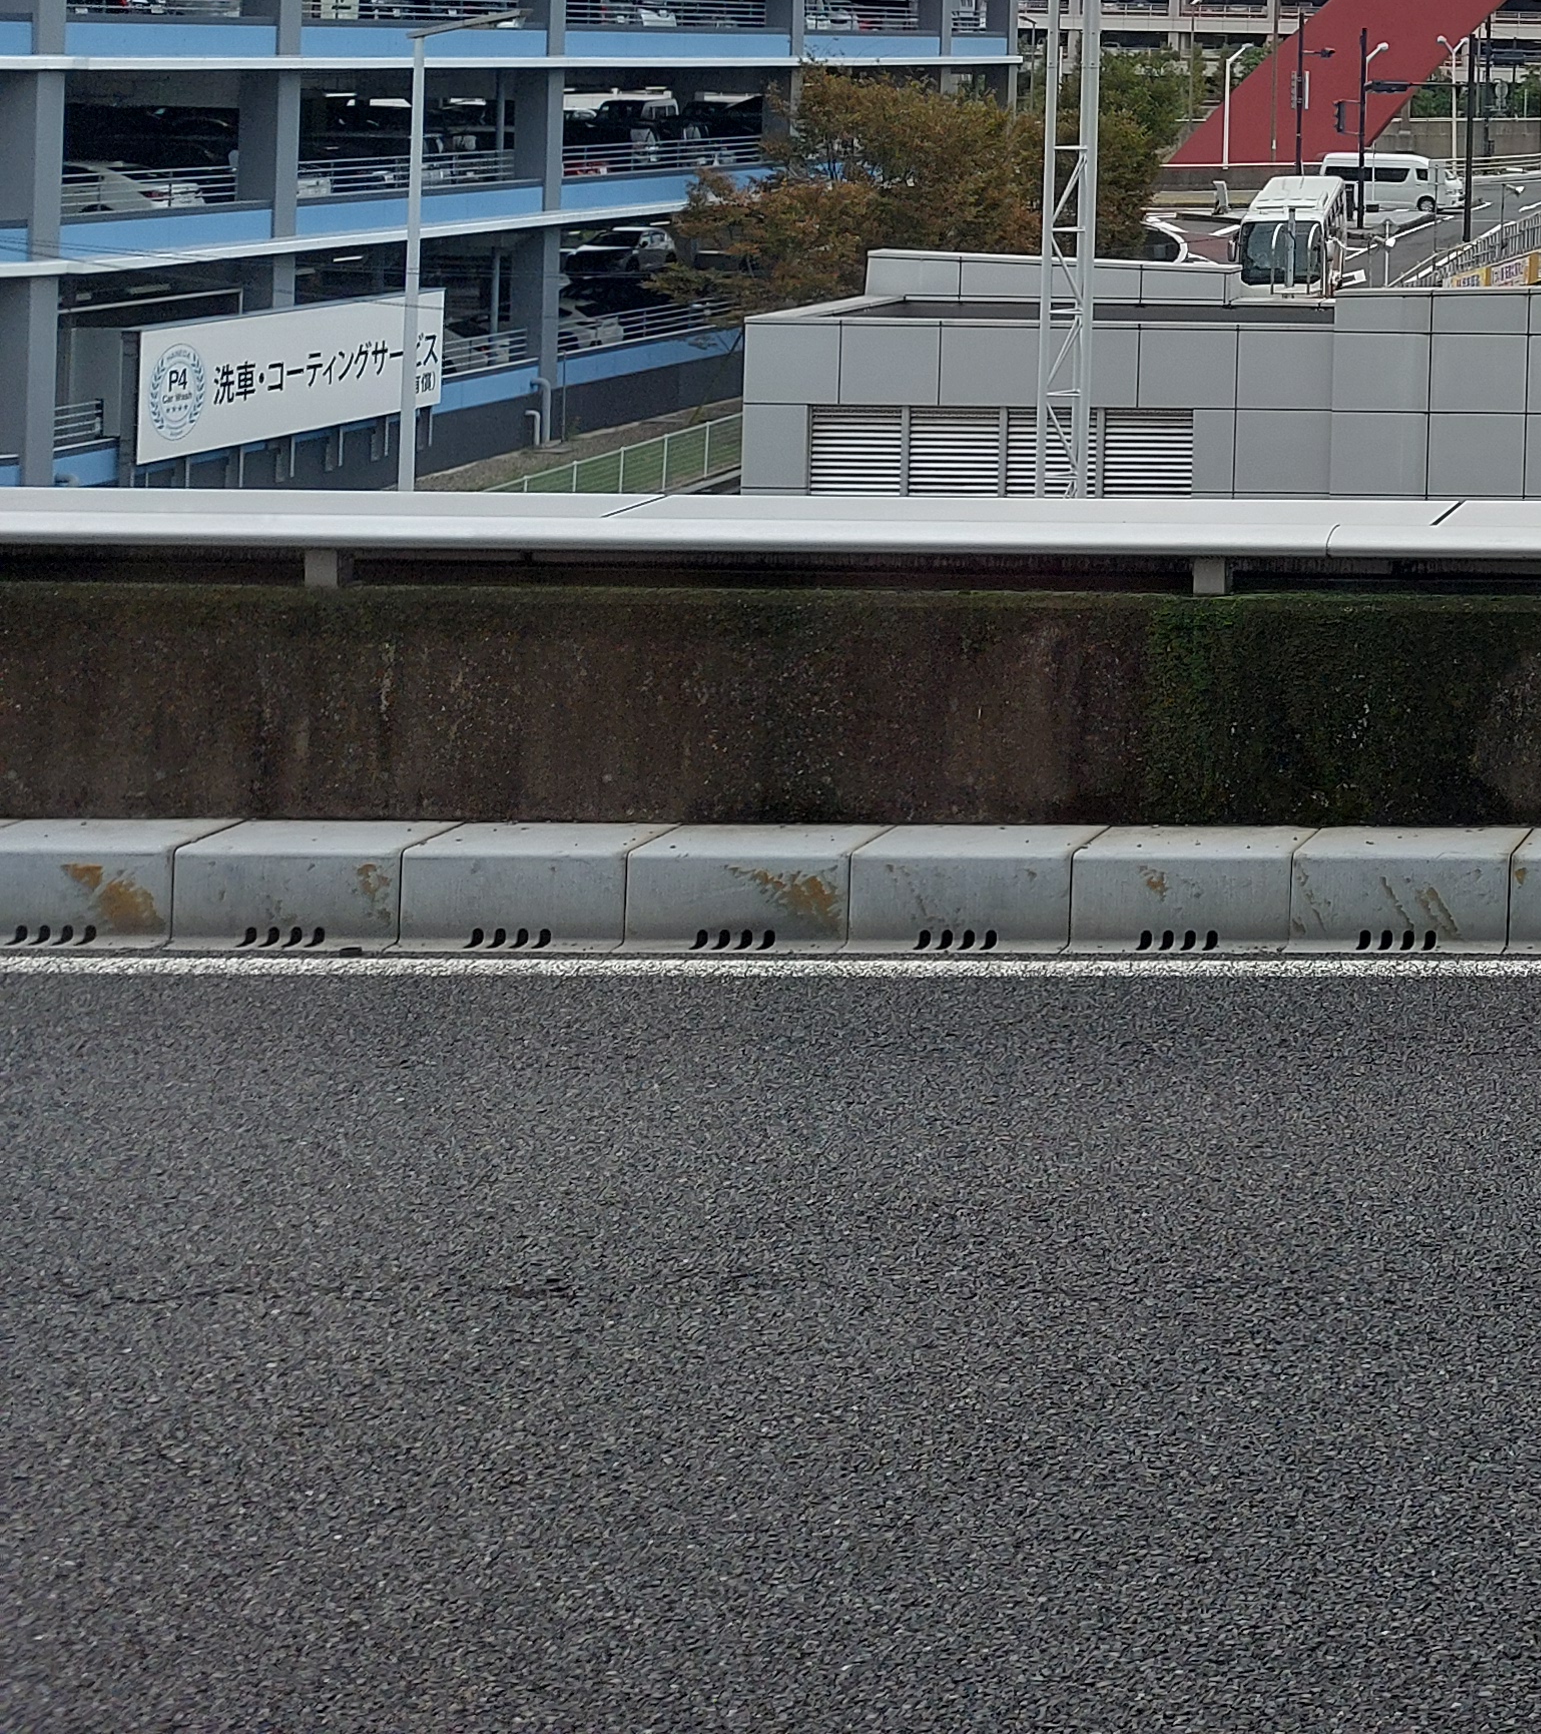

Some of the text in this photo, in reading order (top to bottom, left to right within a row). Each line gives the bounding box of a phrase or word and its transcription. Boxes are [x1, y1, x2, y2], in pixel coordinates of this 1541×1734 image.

[168, 368, 188, 393] P4
[162, 391, 193, 405] Car Wash
